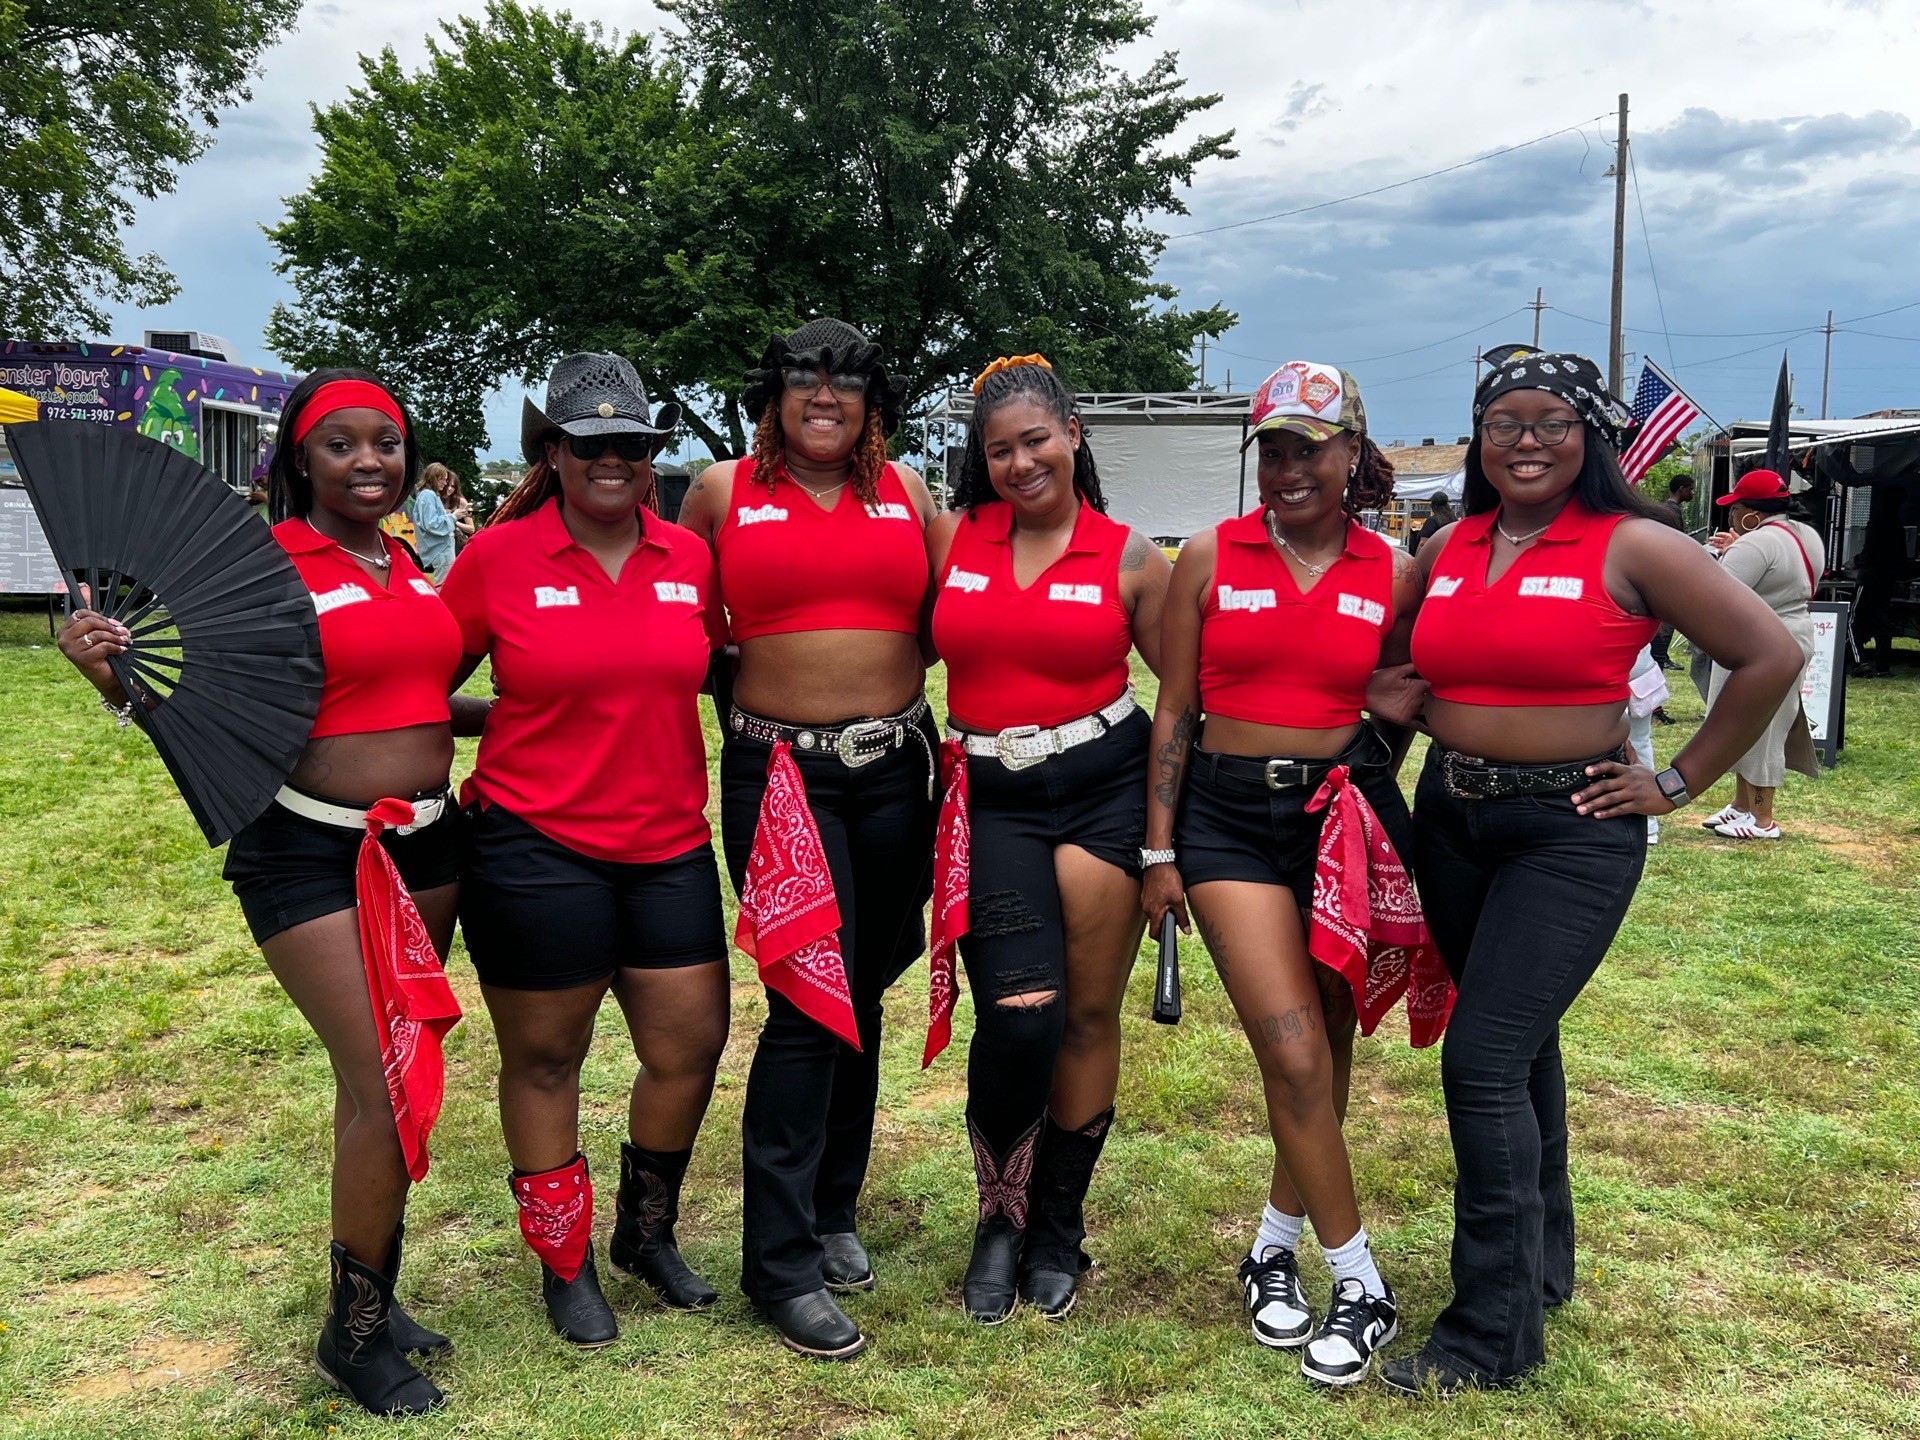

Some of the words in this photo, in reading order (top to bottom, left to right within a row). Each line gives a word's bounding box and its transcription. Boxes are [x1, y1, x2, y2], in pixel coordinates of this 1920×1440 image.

[0, 364, 51, 386] onster
[54, 363, 110, 389] Yogurt
[30, 388, 65, 403] tastes
[66, 389, 100, 405] good!
[47, 406, 115, 421] 972-571-3987
[738, 504, 788, 527] TeeCee
[534, 586, 580, 608] Bri
[1256, 1001, 1316, 1047] 1997
